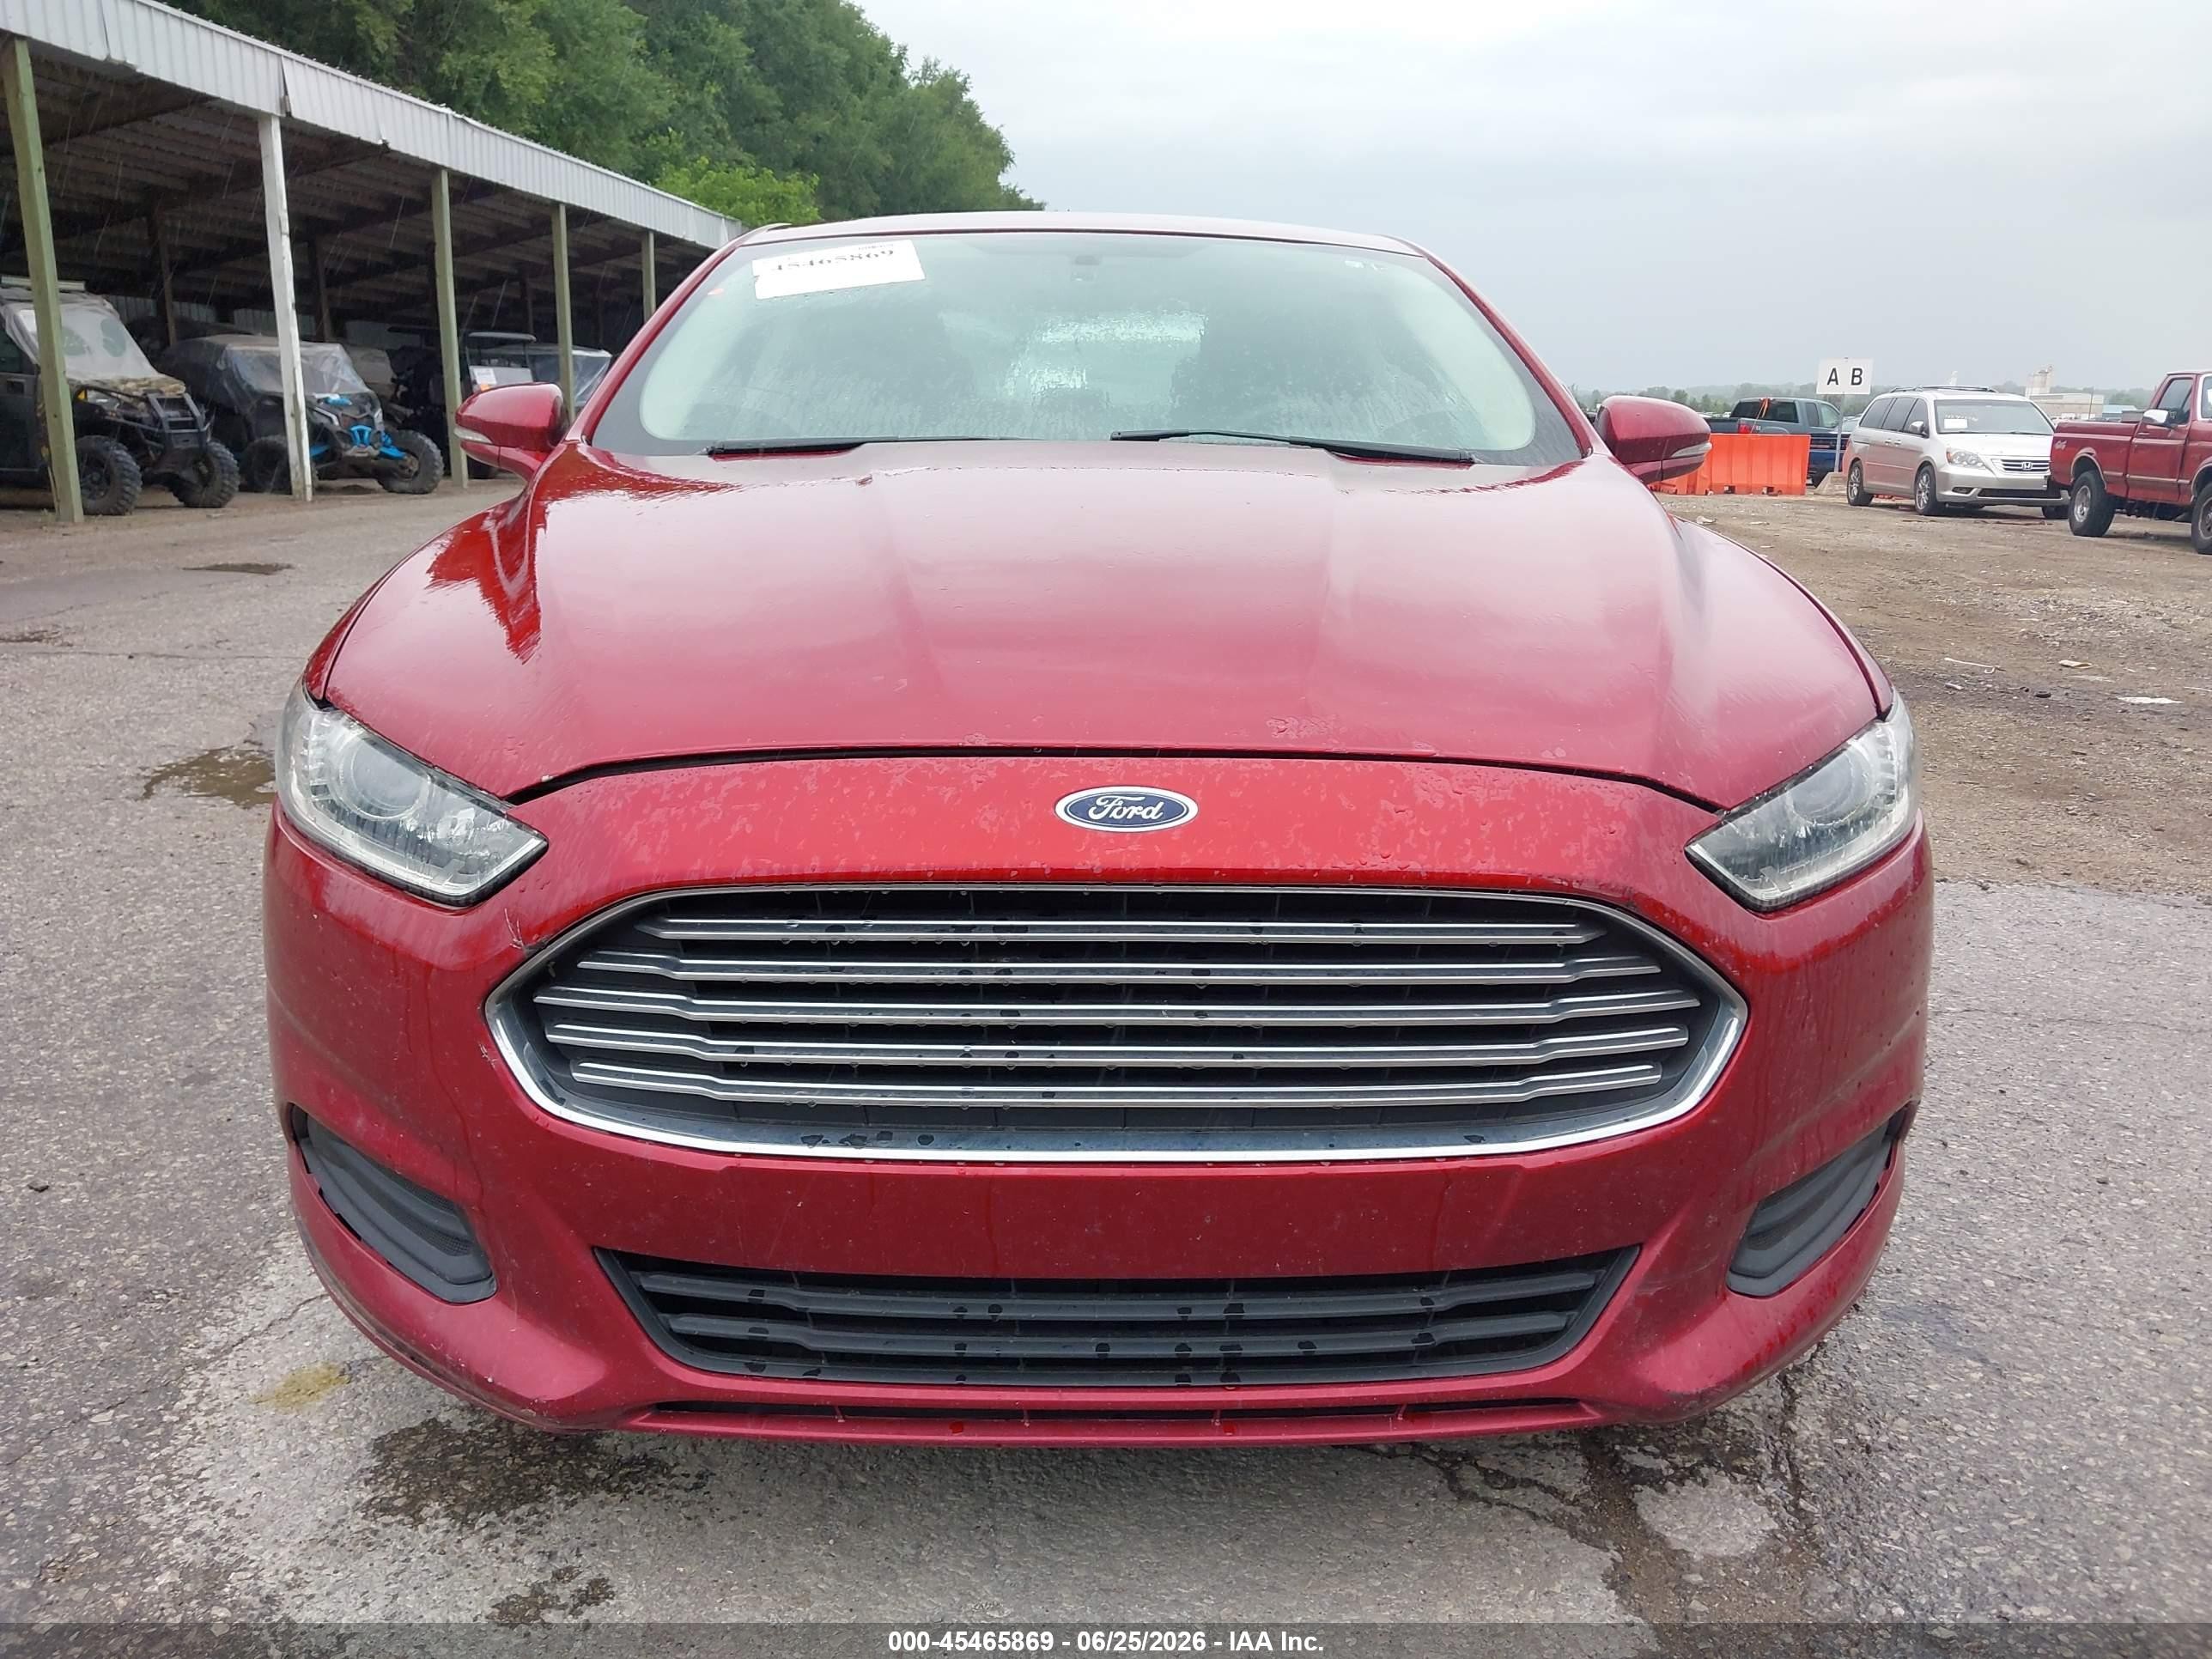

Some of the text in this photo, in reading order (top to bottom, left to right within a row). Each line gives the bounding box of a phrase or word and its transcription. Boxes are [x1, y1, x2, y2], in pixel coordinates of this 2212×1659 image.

[1826, 367, 1863, 386] A B
[1088, 795, 1165, 820] Ford
